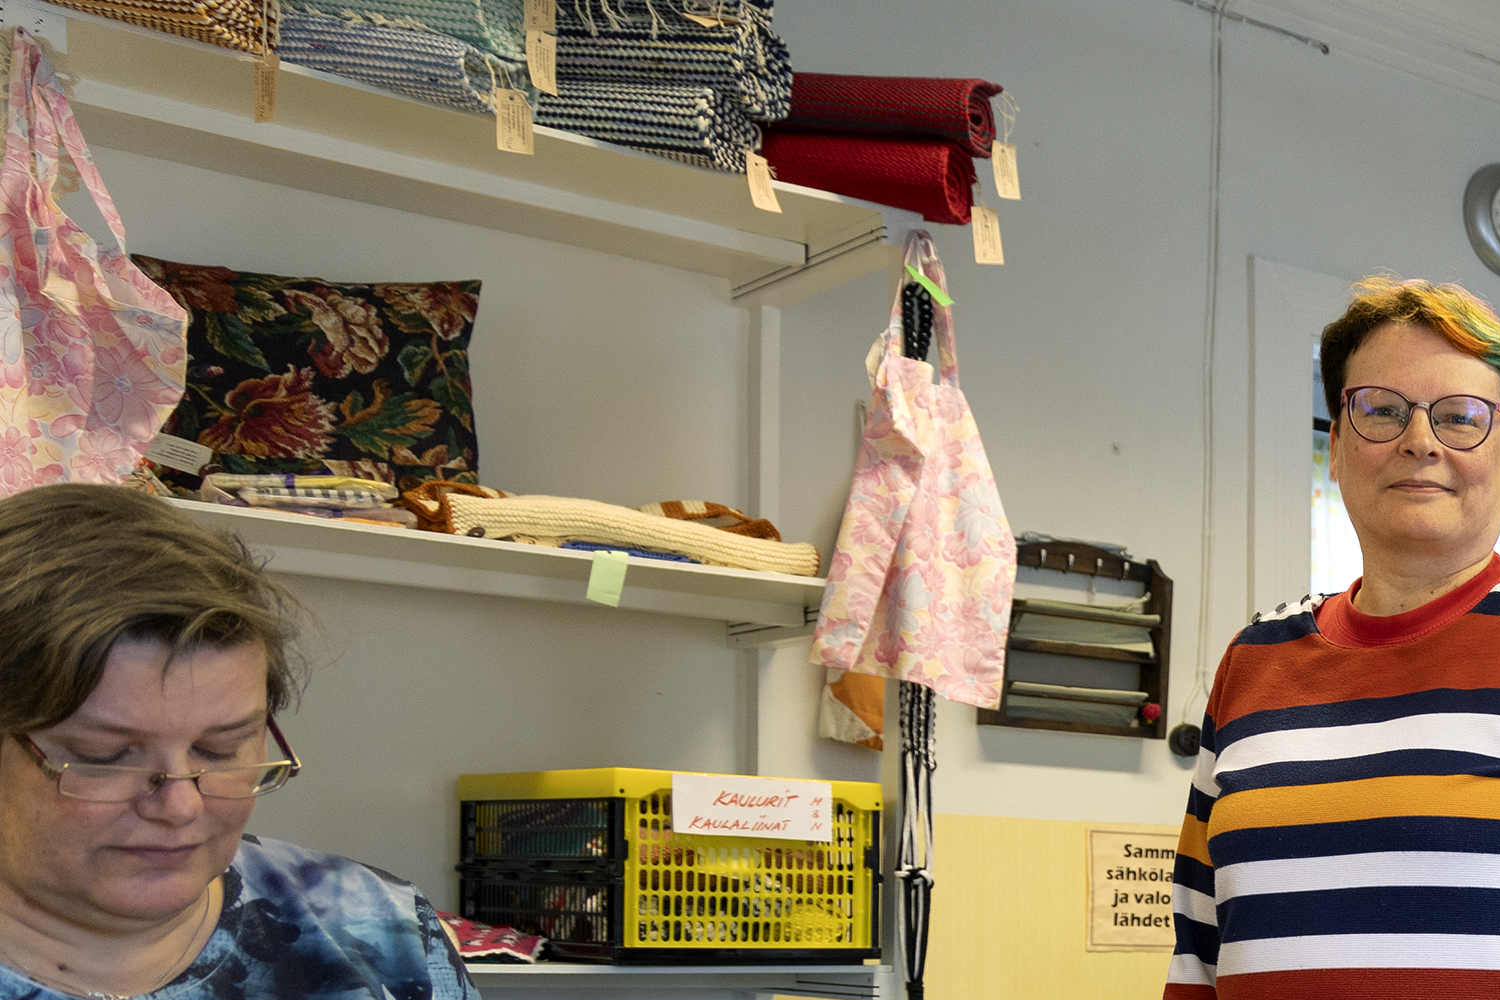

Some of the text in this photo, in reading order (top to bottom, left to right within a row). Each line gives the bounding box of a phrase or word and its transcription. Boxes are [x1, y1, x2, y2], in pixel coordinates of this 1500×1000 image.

[712, 789, 799, 808] KAULURIT
[688, 814, 791, 832] KAULALIINAT
[809, 821, 823, 831] N
[1123, 843, 1175, 859] Samm
[1106, 866, 1174, 883] sähköla
[1111, 889, 1171, 908] ja valo
[1113, 912, 1170, 928] lähdet
